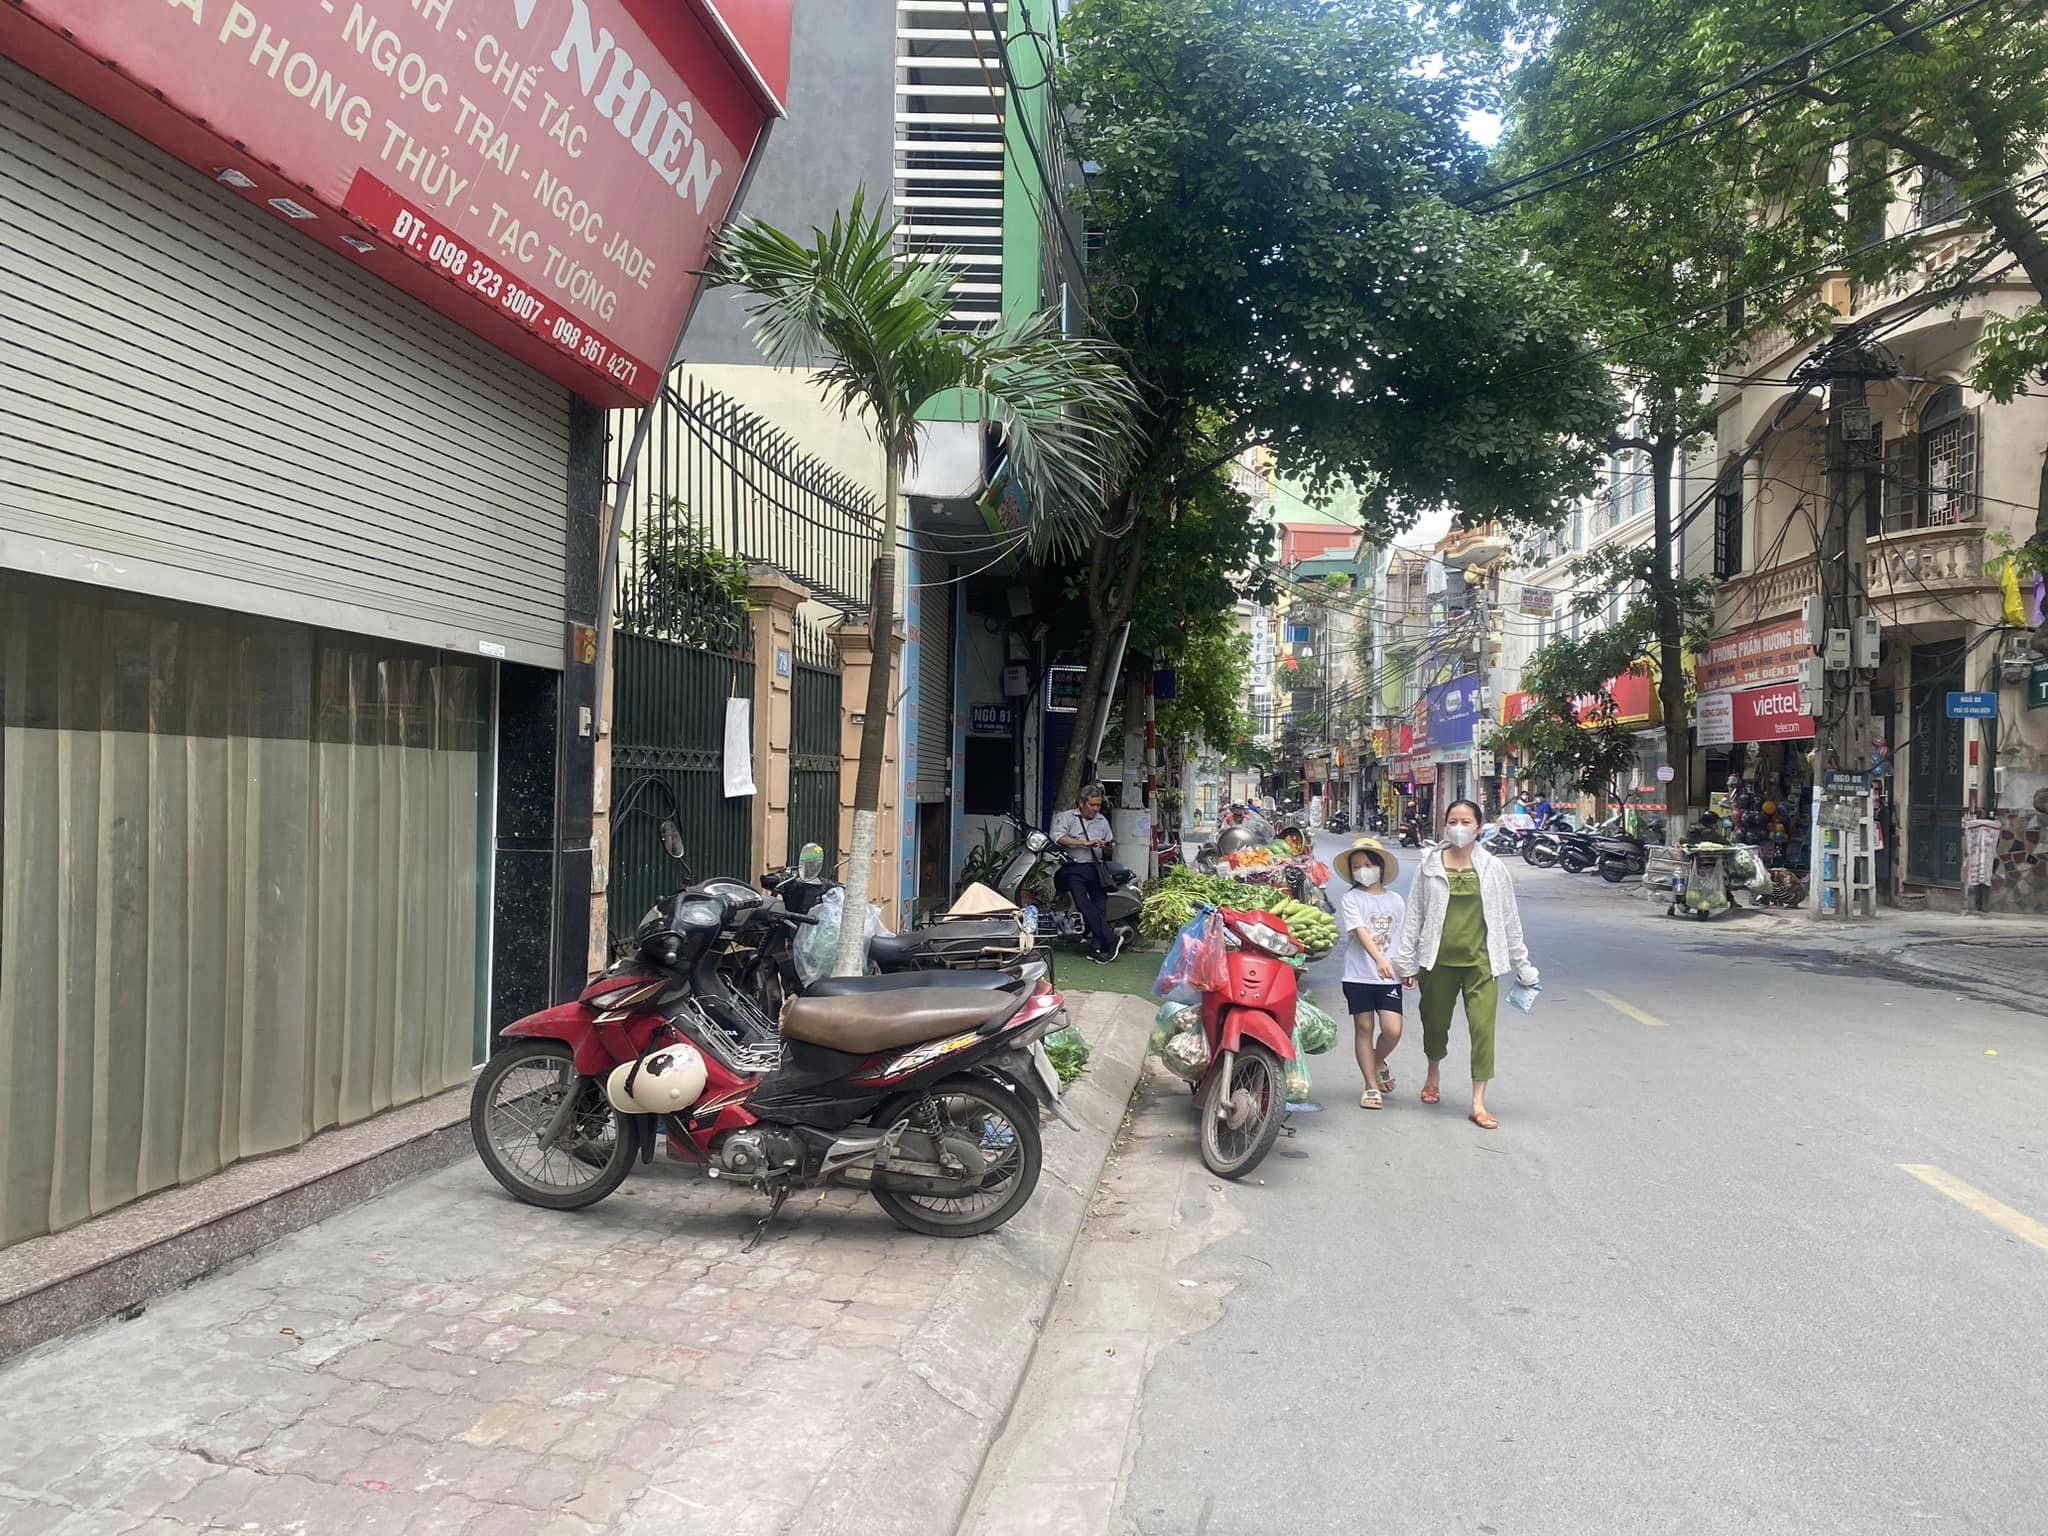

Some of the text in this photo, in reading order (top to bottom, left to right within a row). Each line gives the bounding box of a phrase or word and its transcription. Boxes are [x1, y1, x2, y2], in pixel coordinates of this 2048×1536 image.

[218, 0, 372, 142] PHONG
[380, 118, 469, 208] THỦY
[487, 202, 541, 263] TẠC
[542, 243, 618, 323] TƯỢNG
[341, 2, 449, 113] NGỌC
[453, 95, 521, 176] TRAI
[532, 168, 604, 244] NGỌC
[602, 231, 657, 290] JADE
[474, 34, 545, 112] CHẾ
[537, 91, 588, 158] TÁC
[551, 0, 722, 215] NHIÊN
[391, 208, 429, 251] ĐT:
[428, 234, 469, 276] 098
[467, 260, 503, 298] 323
[501, 283, 545, 323] 3007
[552, 316, 582, 349] 098
[580, 334, 608, 366] 361
[606, 351, 639, 386] 4271
[779, 653, 788, 671] 79
[1753, 691, 1799, 716] viettel
[1775, 722, 1800, 733] telecom
